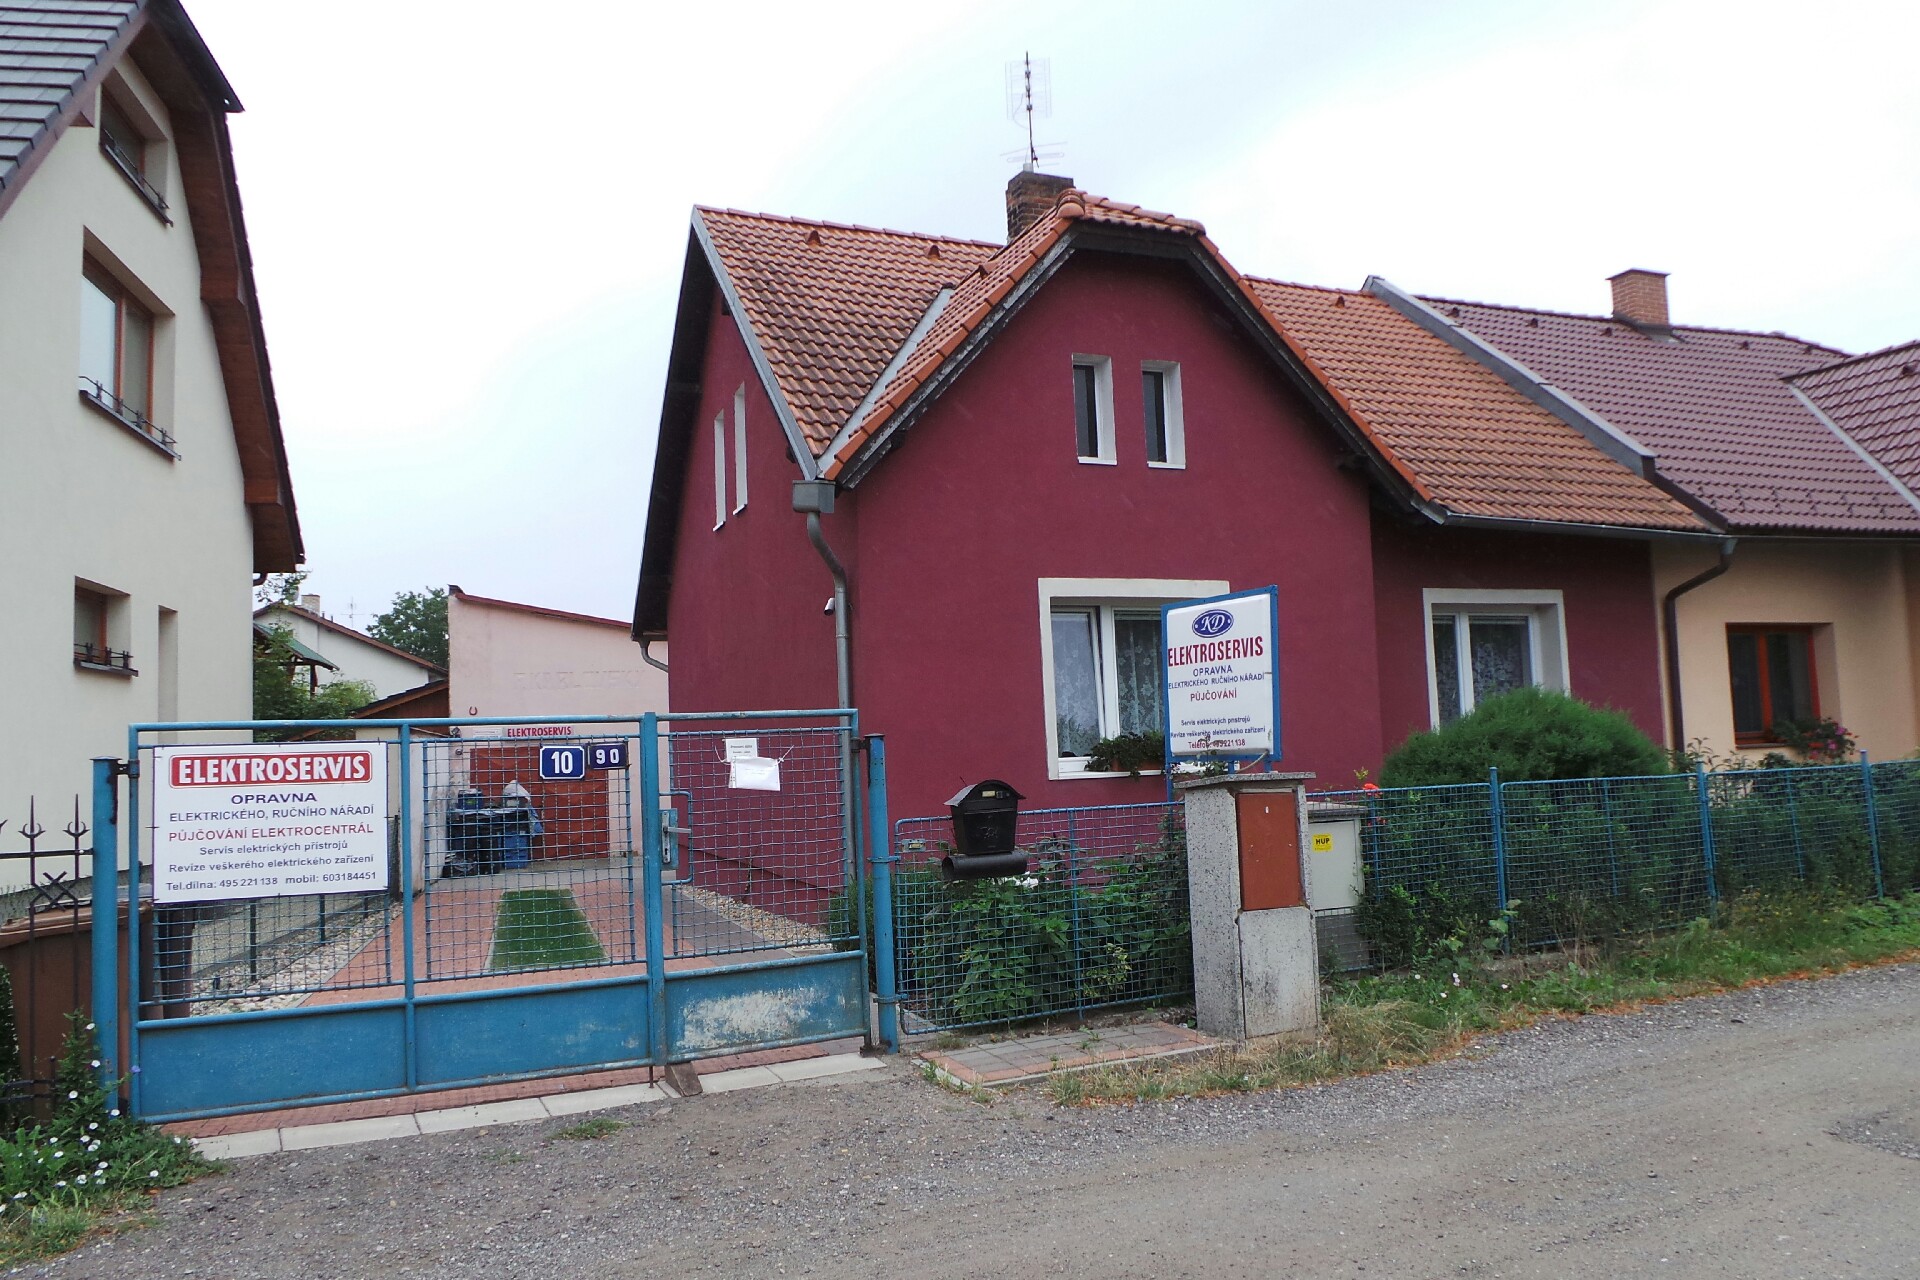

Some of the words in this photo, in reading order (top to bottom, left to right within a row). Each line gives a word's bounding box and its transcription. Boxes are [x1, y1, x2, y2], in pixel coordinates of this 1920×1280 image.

[1168, 636, 1263, 667] ELEKTROSERVIS
[1193, 664, 1233, 677] OPRAVNA
[1211, 675, 1238, 685] RUČNÍHO
[1240, 671, 1265, 682] NÁŘADÍ
[1190, 688, 1237, 702] PŮJČOVÁNÍ
[508, 726, 572, 737] ELEKTROSERVIS
[550, 751, 573, 774] 10
[596, 748, 619, 764] 90
[178, 756, 365, 784] ELEKTROSERVIS
[231, 792, 318, 804] OPRAVNA
[170, 808, 269, 822] ELEKTRICKÉHO,
[272, 806, 327, 818] RUČNÍHO
[330, 804, 374, 815] NÁŘADÍ
[169, 827, 248, 842] PŮJČOVÁNÍ
[252, 822, 374, 838] ELEKTROCENTRÁL
[200, 846, 234, 856] Servis
[237, 842, 301, 854] elektrických
[304, 840, 348, 852] přístrojů
[169, 863, 206, 872] Revize
[210, 860, 265, 870] veškerého
[268, 857, 332, 868] elektrického
[334, 854, 374, 864] zařízení
[286, 874, 319, 884] mobil:
[322, 872, 376, 882] 603184451
